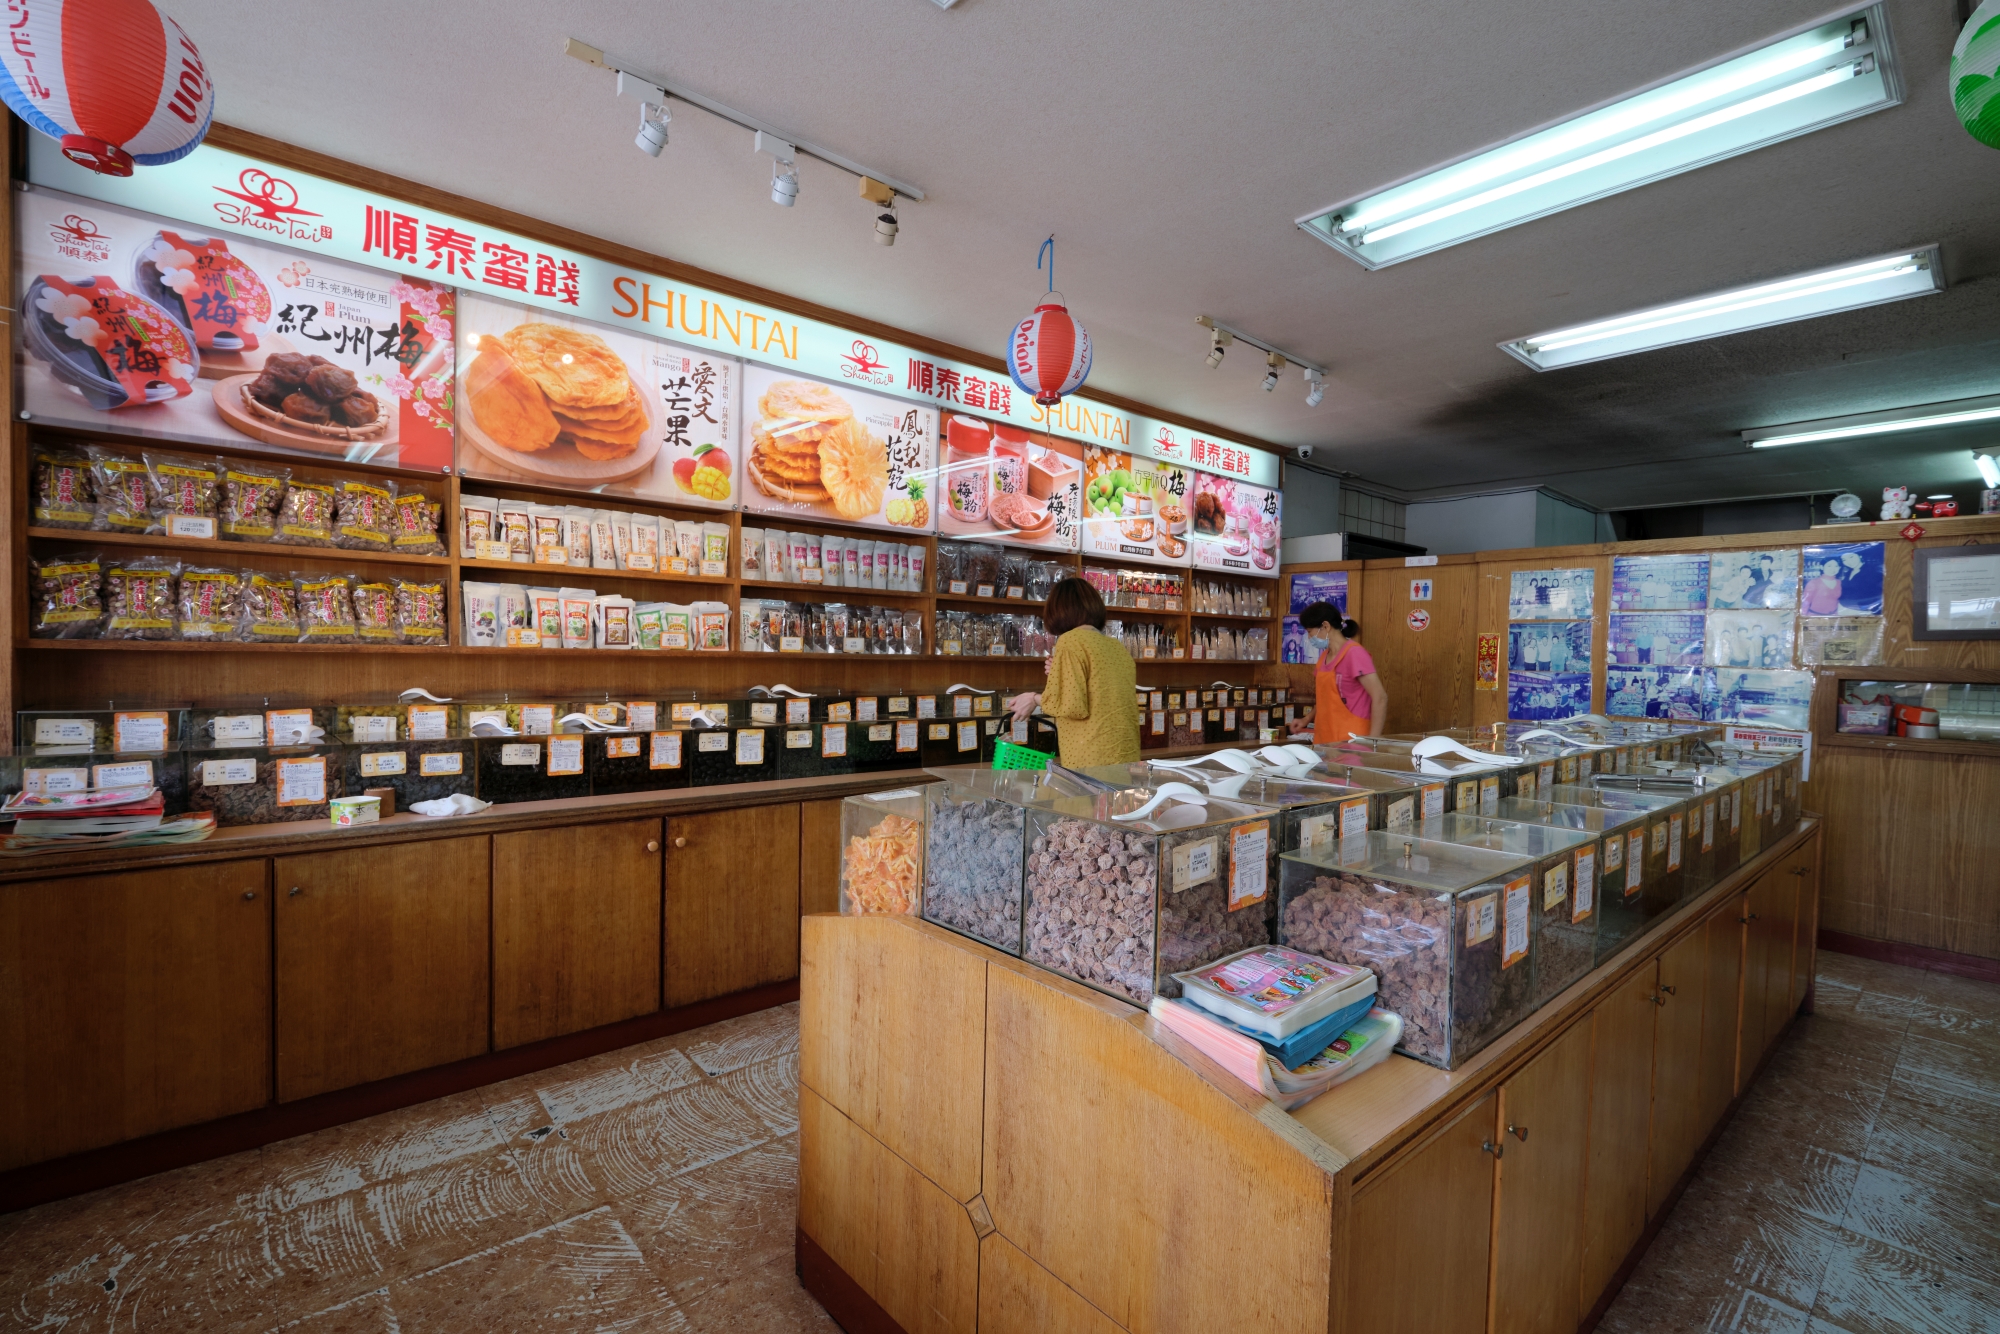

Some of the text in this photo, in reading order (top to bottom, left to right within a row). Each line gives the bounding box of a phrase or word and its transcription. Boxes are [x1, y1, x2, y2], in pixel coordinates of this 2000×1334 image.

[8, 0, 50, 99] ンビール
[362, 204, 580, 308] 順泰蜜餞
[190, 255, 245, 329] 紀州梅
[304, 277, 388, 305] 日本完熟梅使用
[338, 303, 361, 313] Japan
[339, 311, 371, 324] Plum
[92, 297, 167, 376] 紀州梅
[277, 303, 430, 370] 紀州梅
[612, 276, 799, 361] SHUNTAI
[652, 359, 681, 372] Mango
[1016, 319, 1035, 374] Orion
[661, 376, 692, 447] 芒果
[691, 361, 718, 424] 愛文
[907, 357, 1012, 416] 順泰蜜餞
[865, 416, 893, 428] Pineapple
[901, 409, 923, 469] 鳳梨
[1030, 394, 1131, 446] SHUNTAI
[1190, 436, 1251, 477] 順泰蜜餞
[957, 480, 978, 513] 梅粉
[1047, 491, 1072, 537] 梅粉
[1095, 540, 1117, 551] PLUM
[1203, 556, 1221, 565] PLUM
